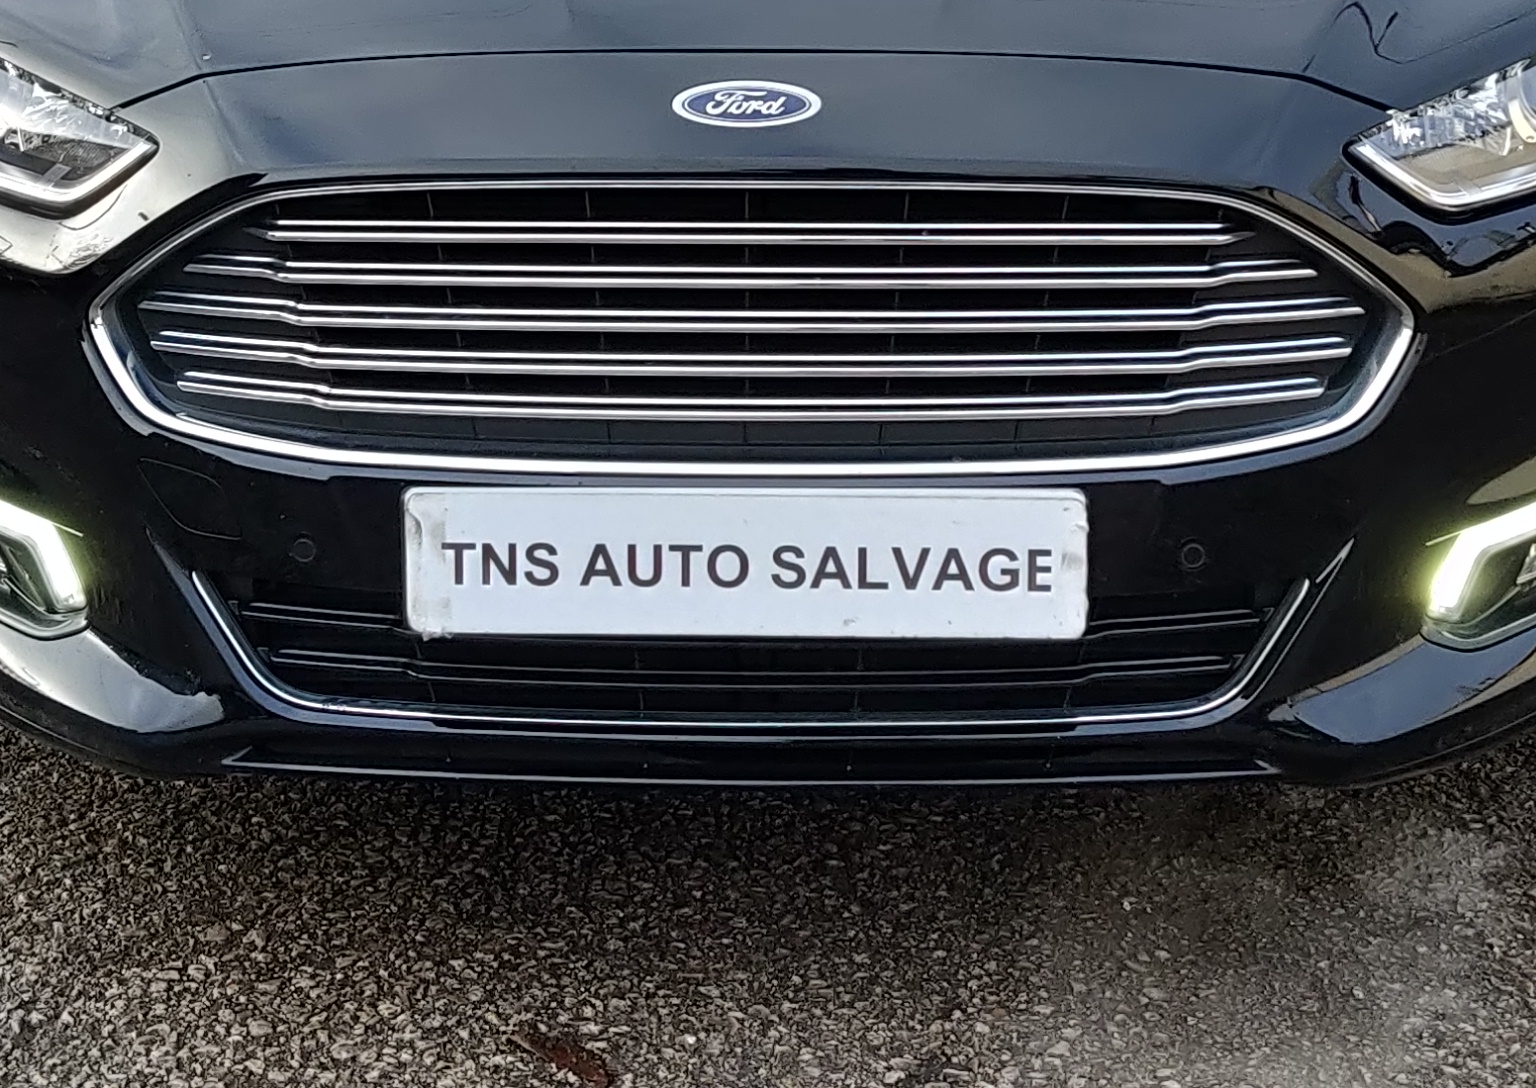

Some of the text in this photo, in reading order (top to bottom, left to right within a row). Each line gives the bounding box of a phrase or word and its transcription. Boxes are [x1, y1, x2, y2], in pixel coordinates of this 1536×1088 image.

[705, 90, 788, 115] Ford
[441, 541, 1052, 593] TNS AUTO SALVAGE
